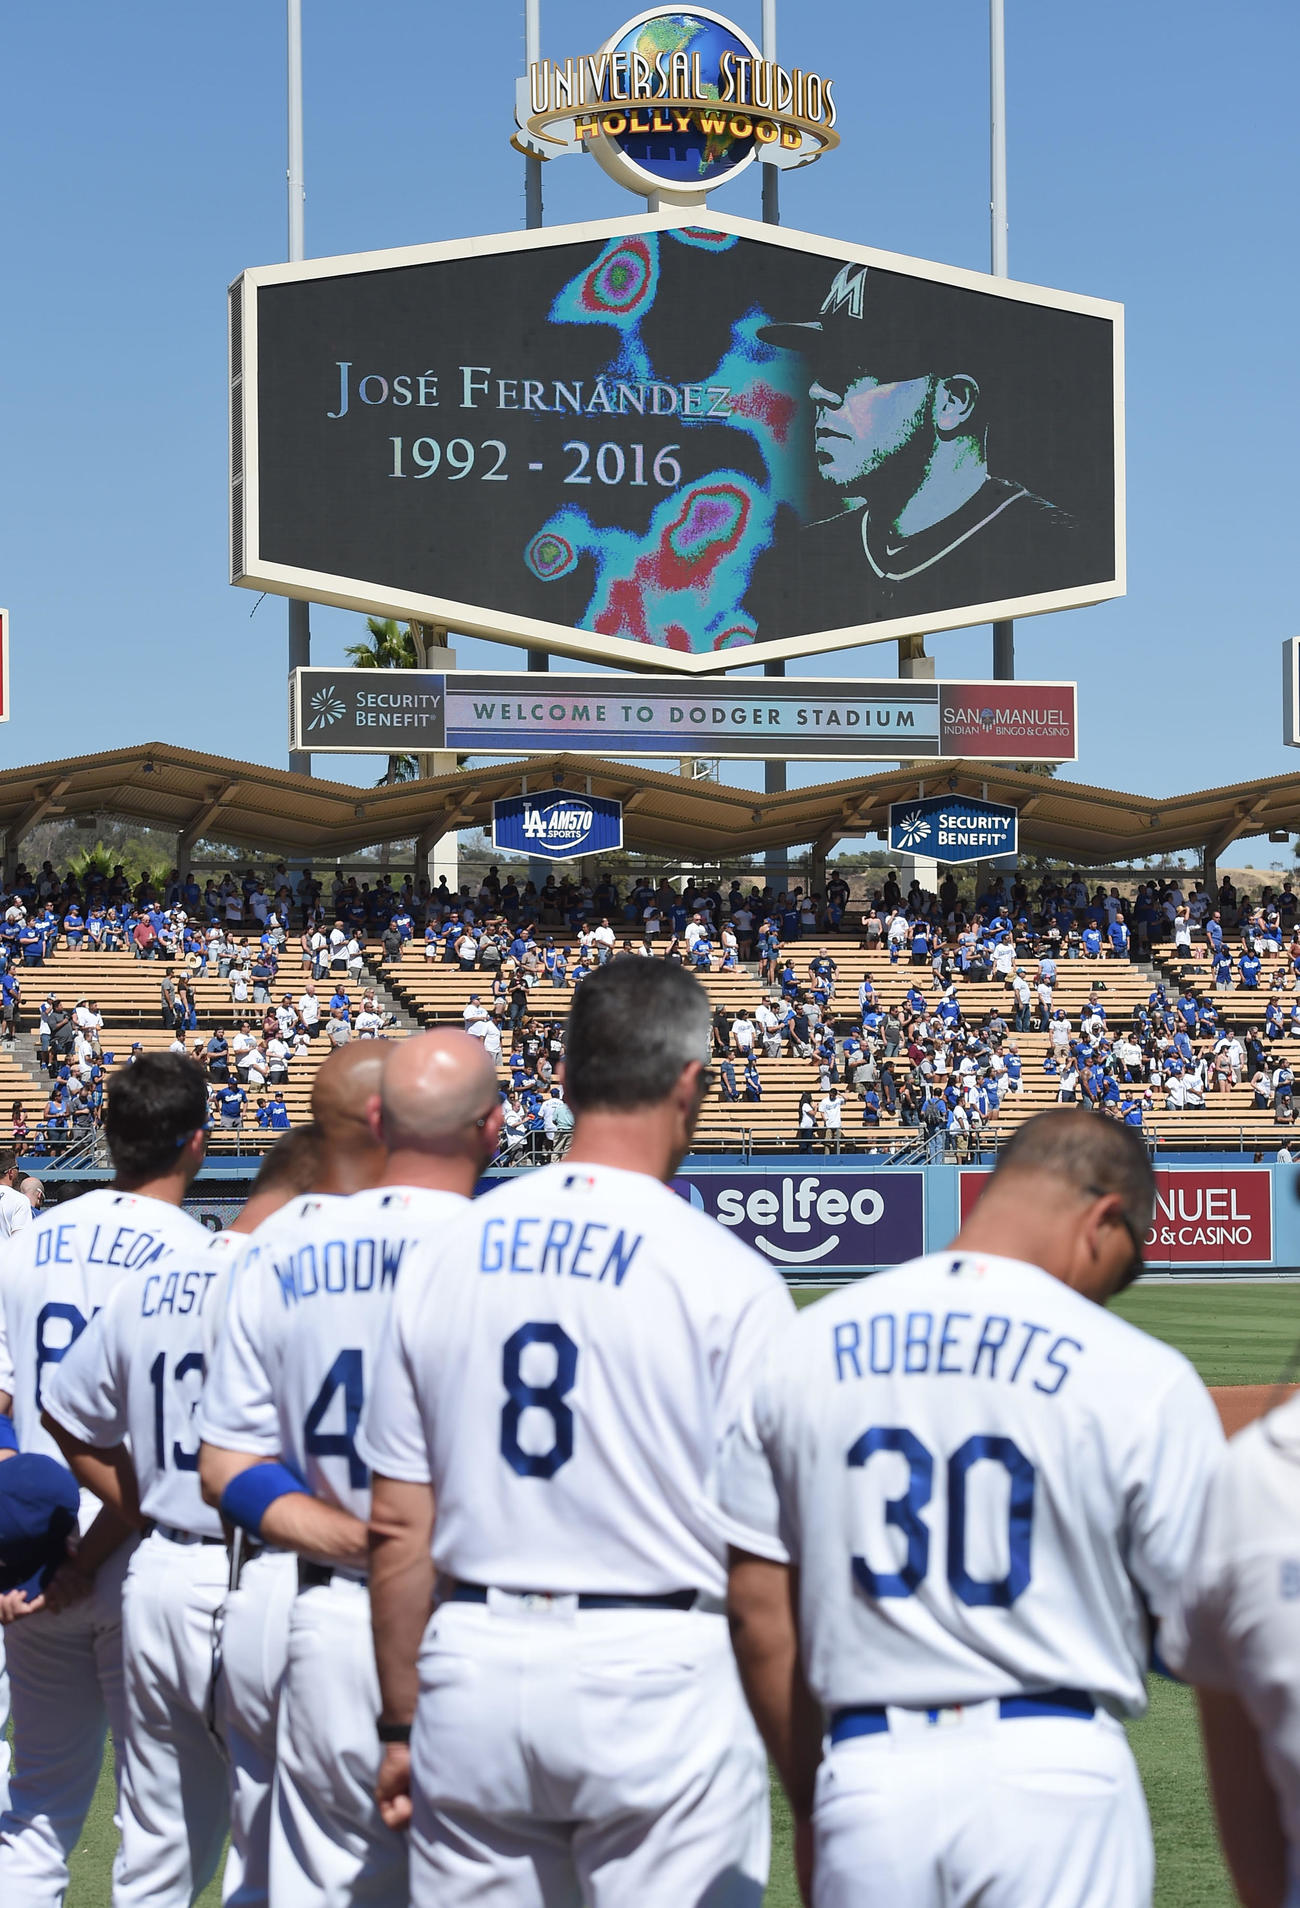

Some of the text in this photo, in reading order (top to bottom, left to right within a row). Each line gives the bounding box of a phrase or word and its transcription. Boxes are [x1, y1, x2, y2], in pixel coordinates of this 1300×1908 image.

[530, 50, 837, 129] UNIVERSAL STUDIOS
[574, 108, 803, 151] HOLLYWOOD
[388, 436, 509, 482] 1992
[562, 440, 682, 487] 2016
[356, 691, 440, 708] SECURITY
[473, 703, 915, 727] WELCOME TO DODGER STADIUM
[943, 708, 1070, 725] SAN MANUEL
[944, 726, 1070, 737] INDIAN BINGO & CASINO
[522, 802, 593, 838] LA AM570
[547, 830, 582, 838] SPORTS
[939, 814, 1011, 830] SECURITY
[34, 1223, 77, 1267] DE
[480, 1216, 644, 1287] GEREN
[1160, 1226, 1176, 1245] &
[1178, 1226, 1252, 1245] CASINO
[274, 1237, 419, 1311] WOODW
[36, 1302, 101, 1412] 8
[833, 1312, 1084, 1395] ROBERTS
[304, 1349, 370, 1490] 4
[501, 1322, 579, 1481] 8
[847, 1427, 1036, 1609] 30
